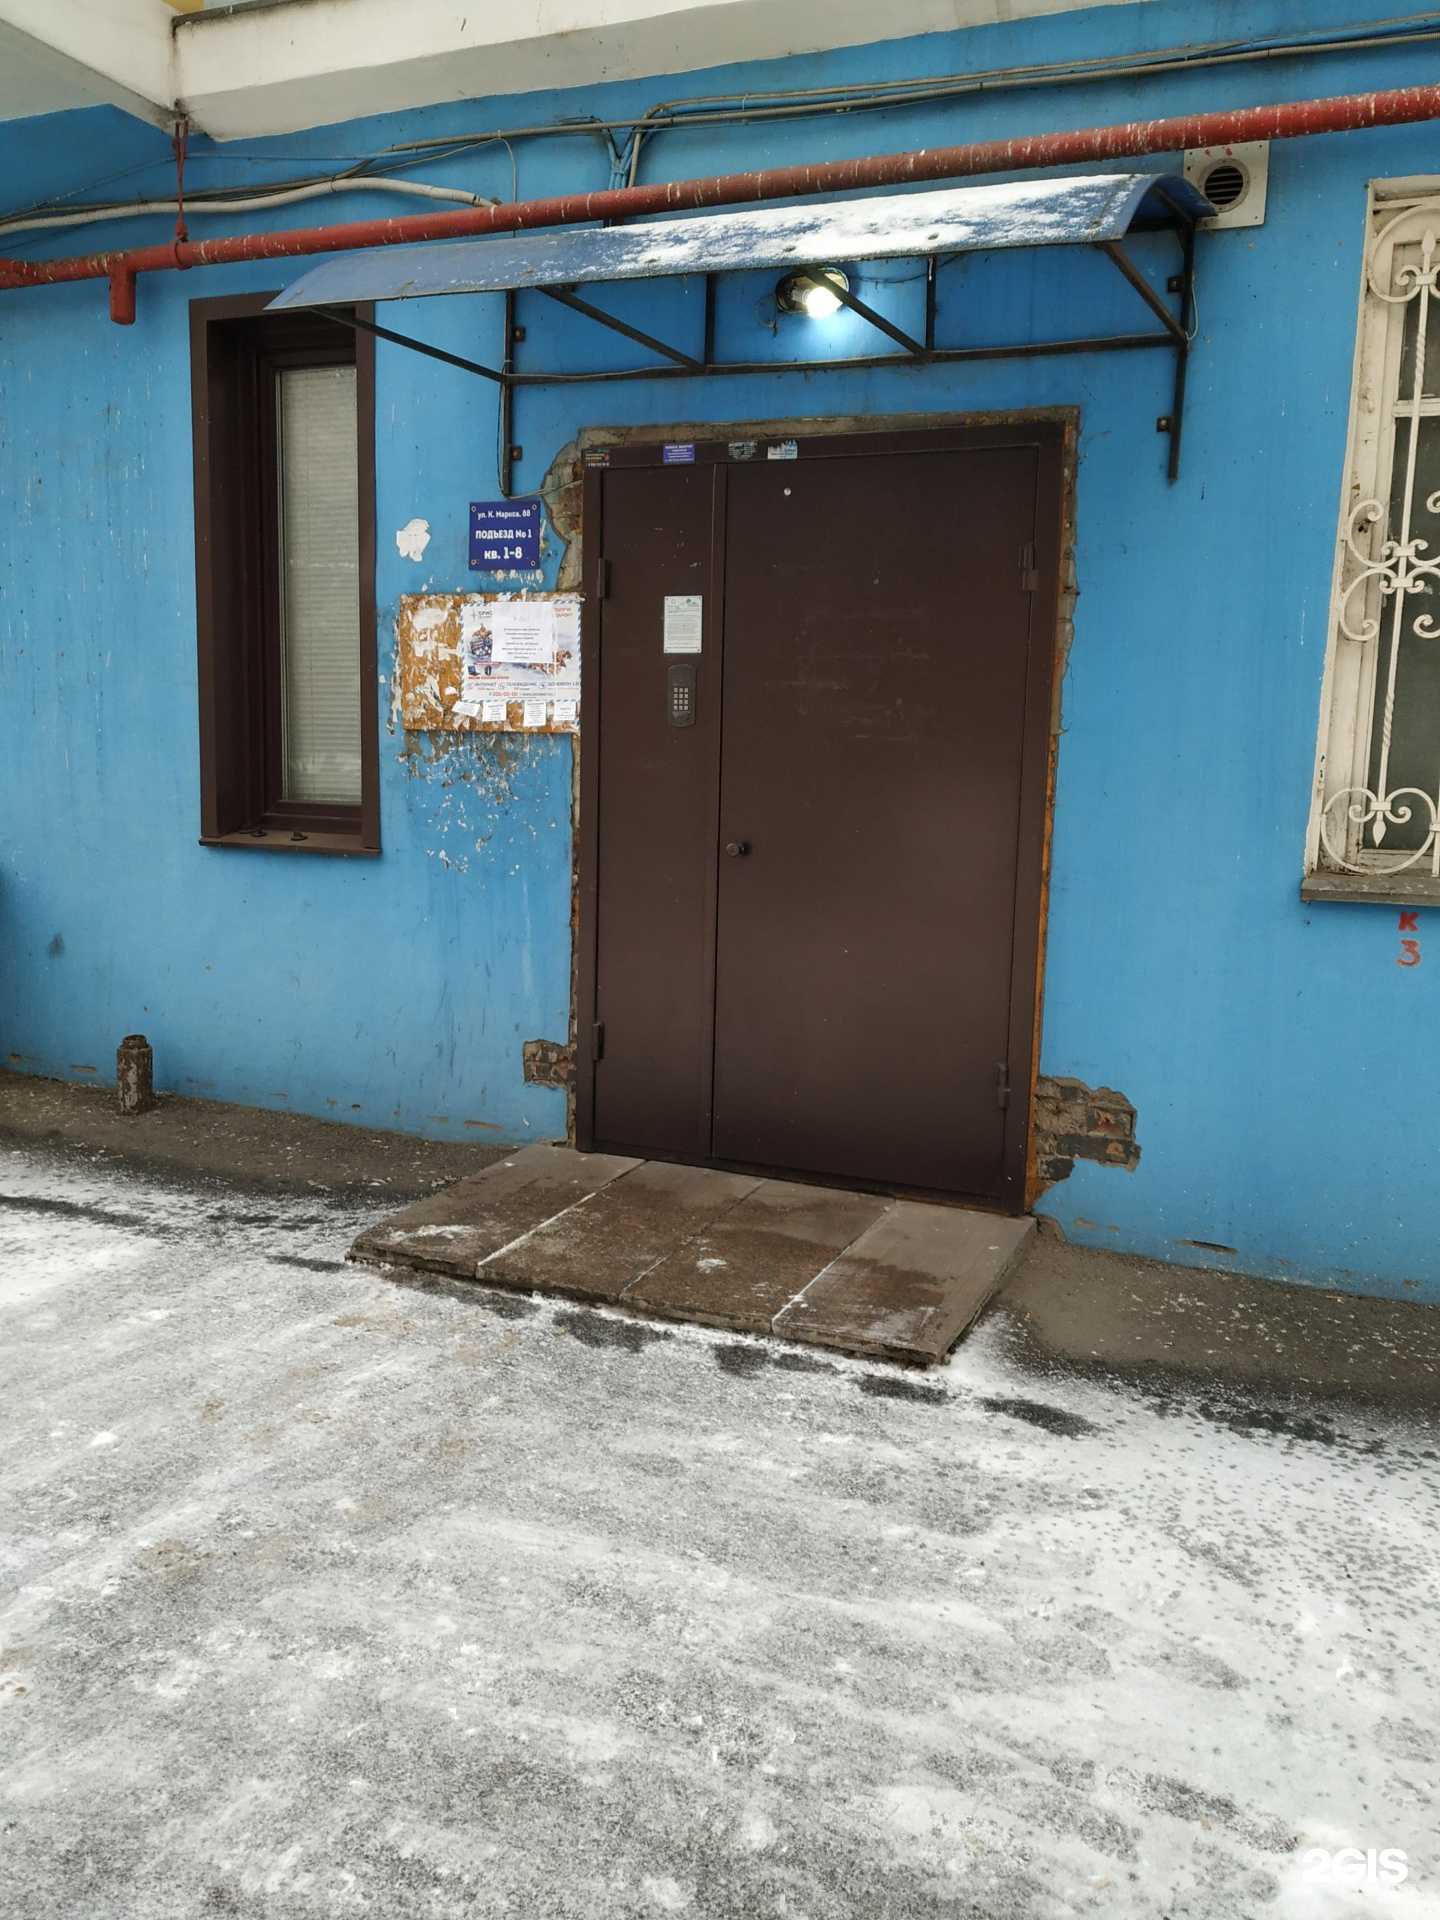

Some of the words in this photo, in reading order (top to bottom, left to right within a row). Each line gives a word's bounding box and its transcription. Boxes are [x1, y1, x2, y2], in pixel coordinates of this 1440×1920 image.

[477, 511, 487, 520] ул.
[484, 550, 501, 559] кв.
[503, 546, 522, 559] 1-8
